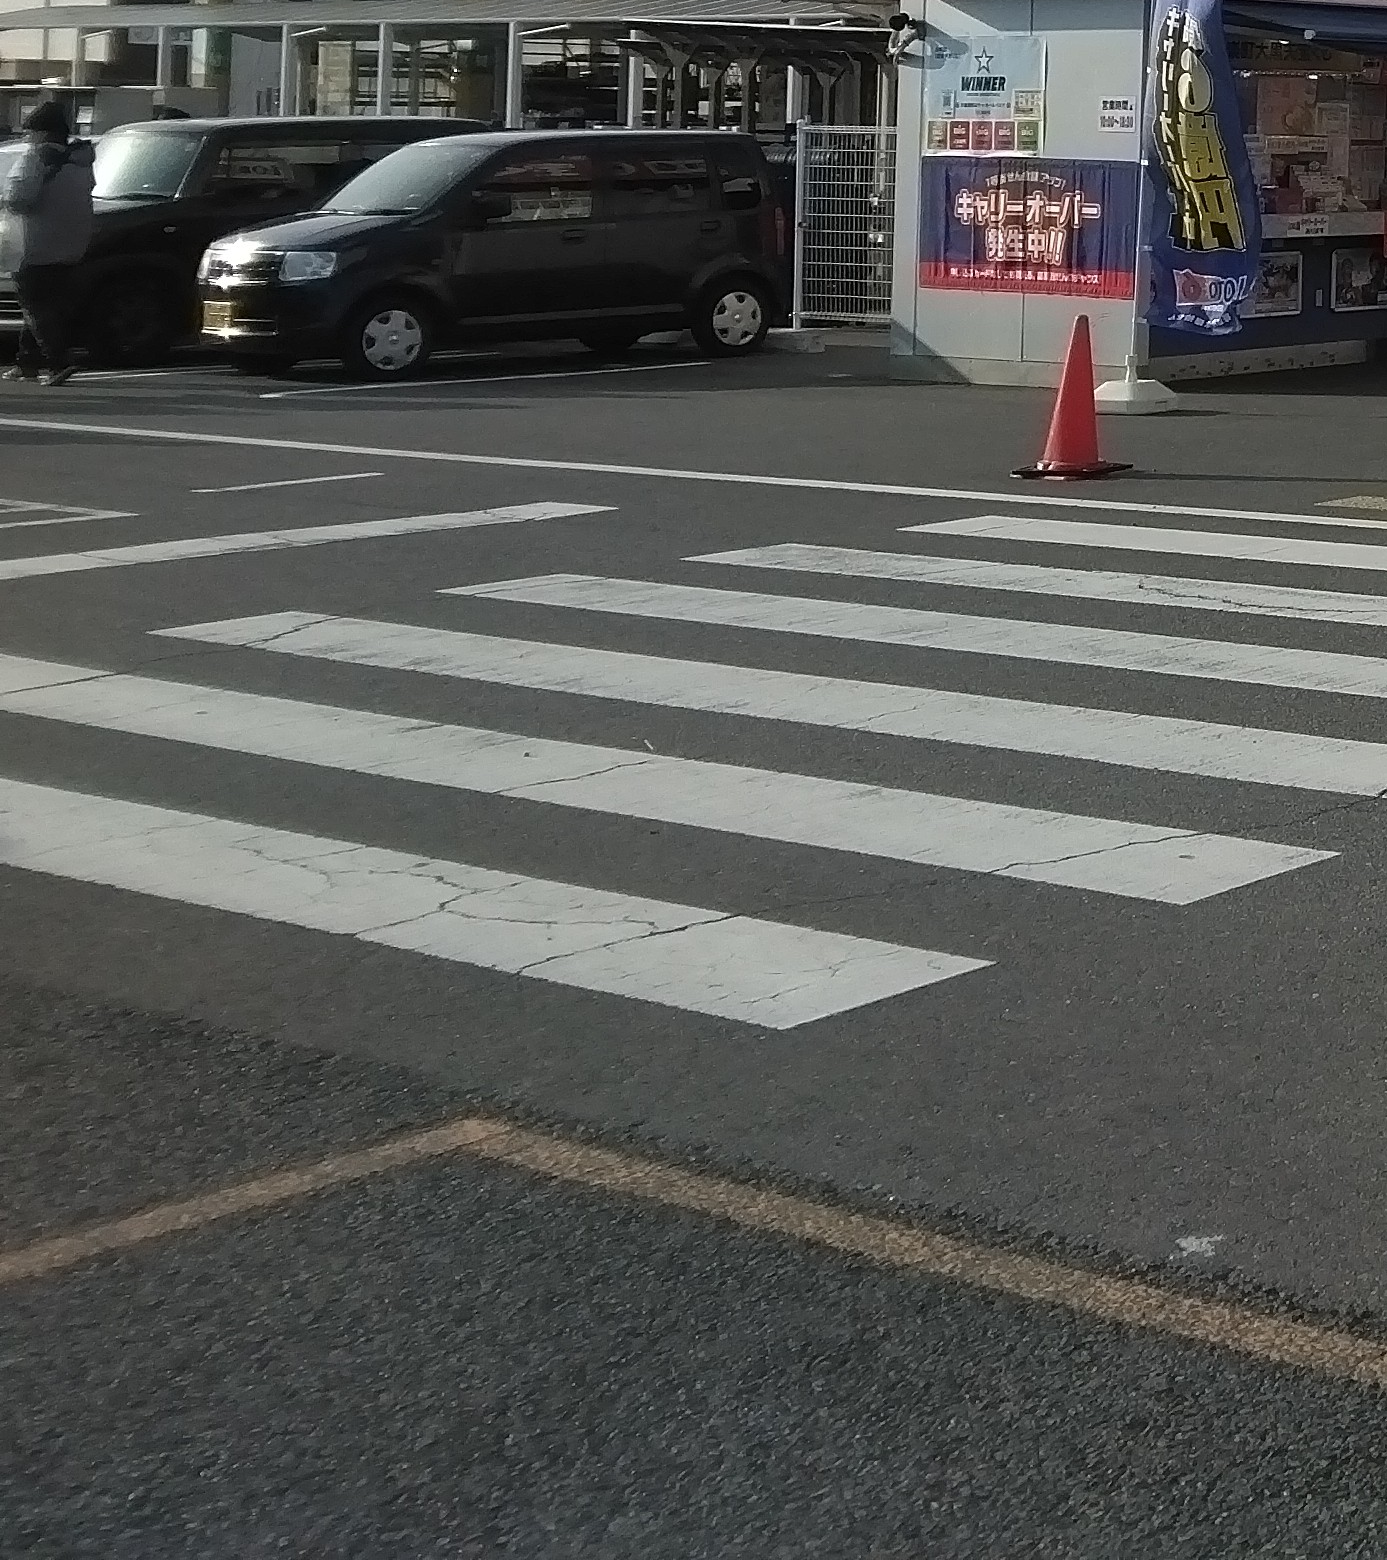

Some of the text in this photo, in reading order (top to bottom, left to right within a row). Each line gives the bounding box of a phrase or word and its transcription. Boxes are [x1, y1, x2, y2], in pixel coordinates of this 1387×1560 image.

[961, 76, 1007, 92] WINNER
[955, 189, 1101, 228] キャリーオーバー
